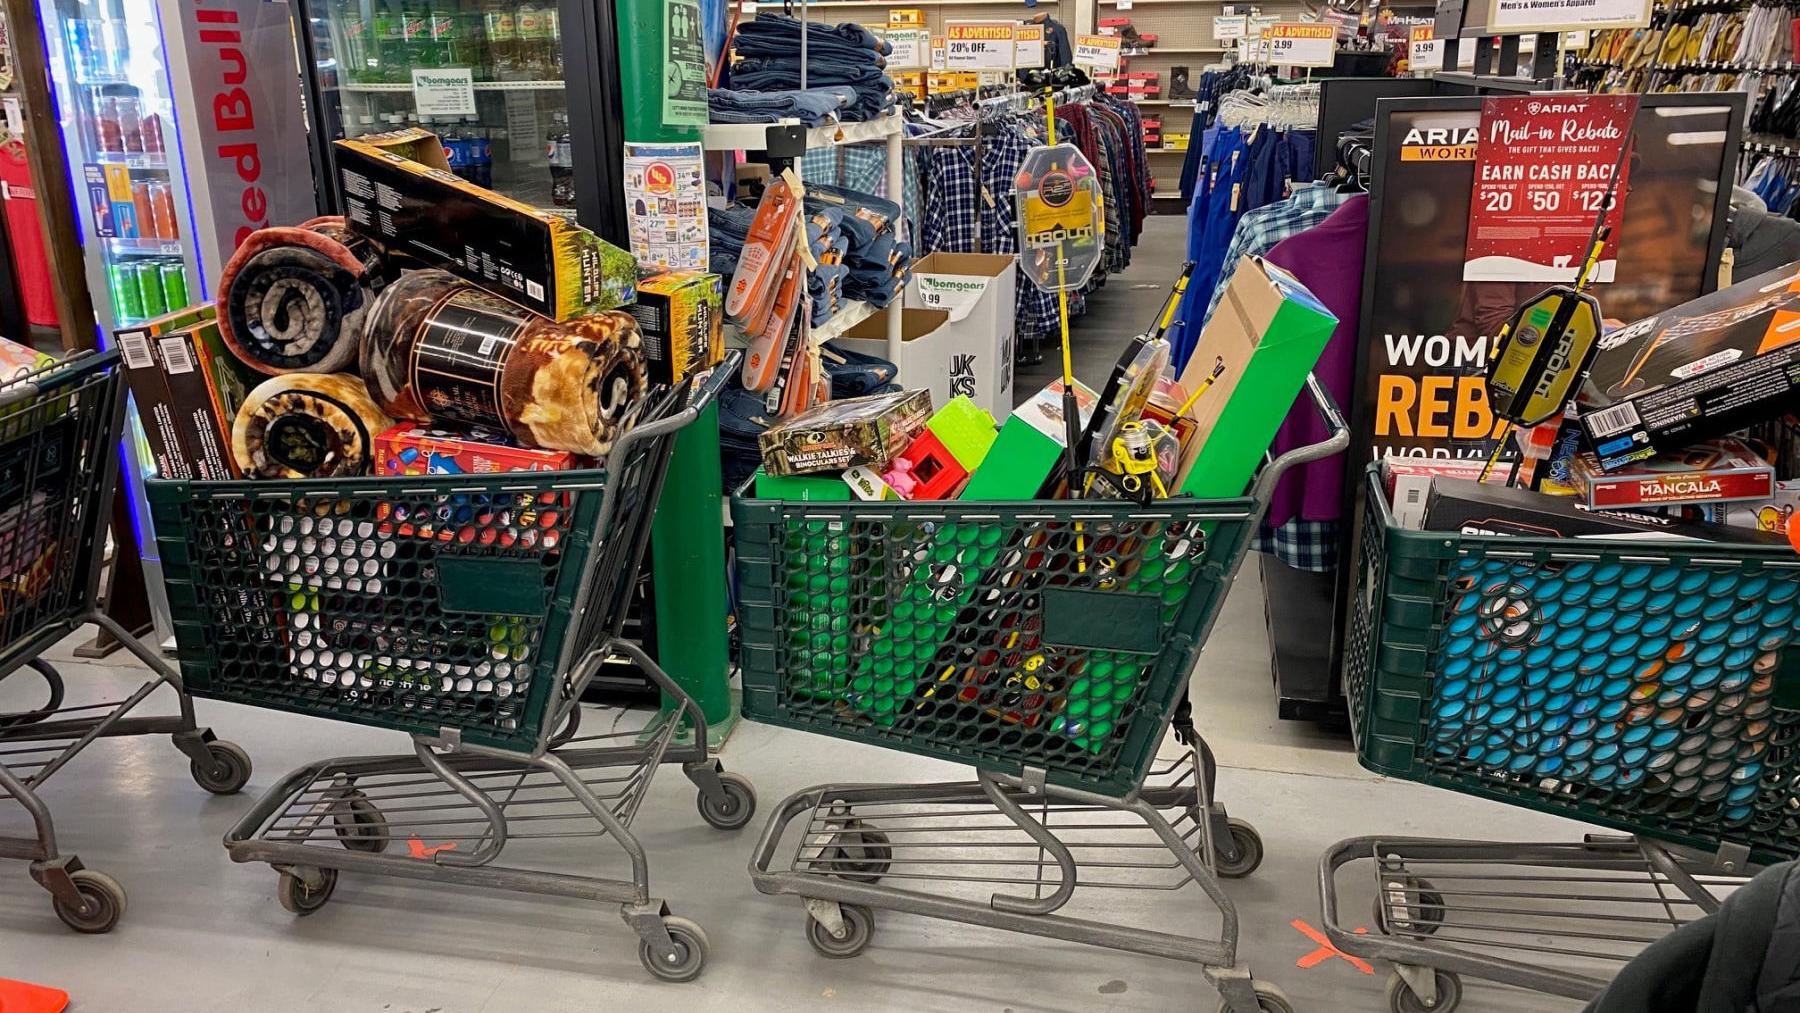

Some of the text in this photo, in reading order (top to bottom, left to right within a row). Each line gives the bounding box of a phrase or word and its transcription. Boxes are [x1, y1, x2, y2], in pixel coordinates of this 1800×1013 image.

[949, 26, 1012, 38] AS ADVERTISED
[1274, 26, 1332, 38] AS ADVERTISED
[1414, 30, 1424, 40] AS
[951, 43, 969, 52] 20%
[971, 43, 986, 52] OFF
[1274, 40, 1292, 48] 3.99
[1416, 43, 1434, 52] 3.99
[193, 9, 255, 131] Bull
[427, 76, 468, 86] bomgaars
[1540, 104, 1586, 113] ARIAT
[1402, 128, 1480, 145] ARIA
[1491, 120, 1622, 144] Mail-in Rebate
[1522, 146, 1536, 154] GIFT
[1482, 166, 1524, 180] EARN
[1529, 165, 1572, 180] CASH
[1480, 192, 1512, 211] $20
[1527, 191, 1560, 211] $50
[582, 249, 590, 304] HUNTER
[932, 278, 984, 291] bomgaars
[1534, 328, 1576, 398] TROUT
[1648, 412, 1686, 428] WARNING:
[787, 450, 816, 462] WALKIE
[817, 448, 848, 460] TALKIES
[796, 456, 850, 468] BINOCULARS SET
[1640, 480, 1721, 496] MANCALA
